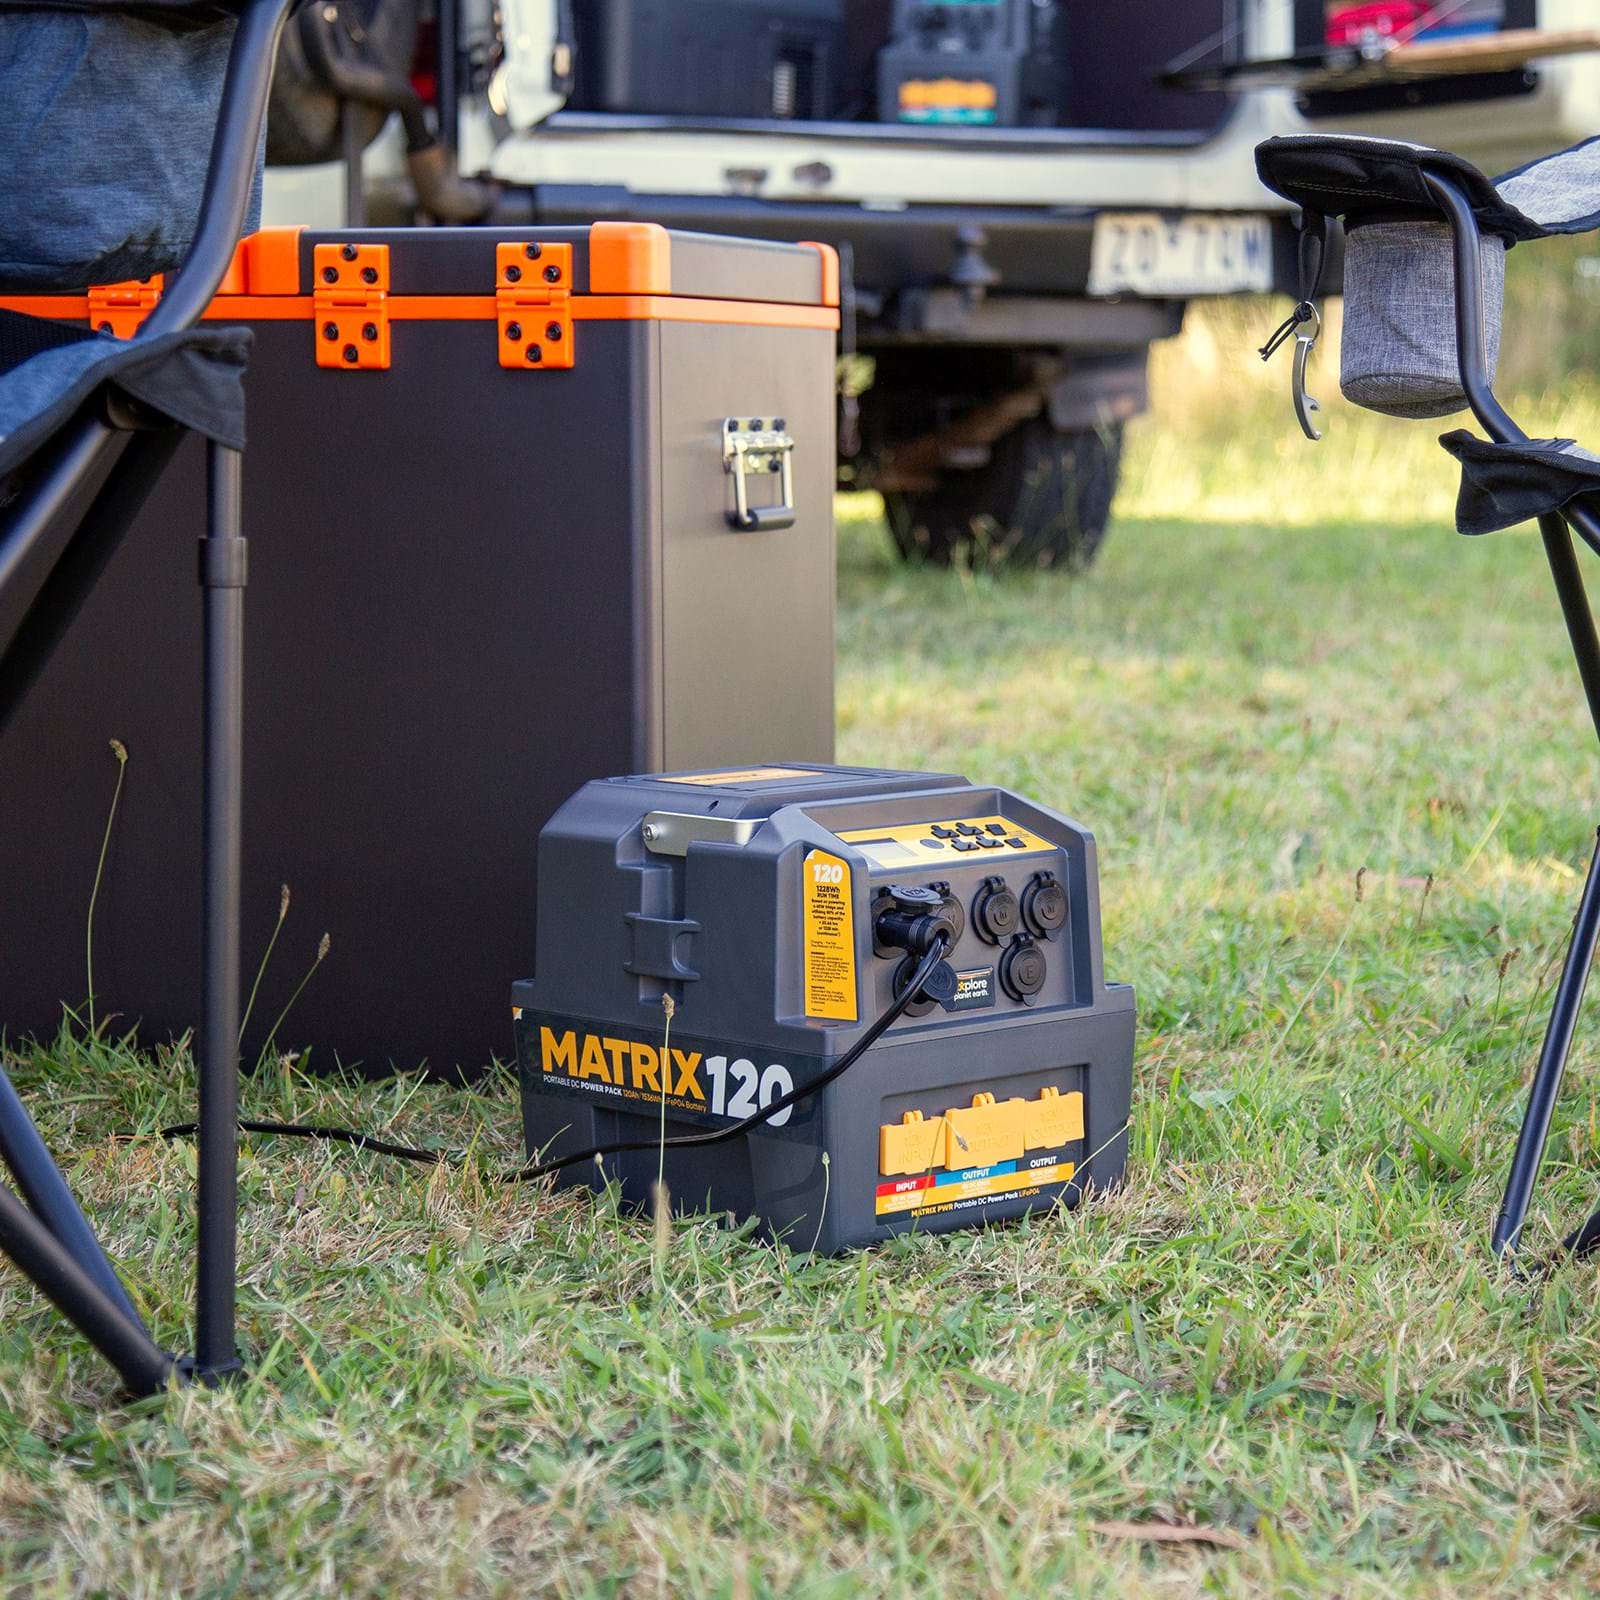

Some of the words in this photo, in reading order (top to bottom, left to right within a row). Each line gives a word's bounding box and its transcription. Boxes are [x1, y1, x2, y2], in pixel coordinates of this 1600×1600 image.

[814, 864, 843, 883] 120
[816, 885, 840, 893] 1228Wh
[958, 979, 987, 993] xplore
[540, 1026, 706, 1101] MATRIX
[705, 1056, 794, 1127] 120
[543, 1074, 570, 1087] PORTABLE
[571, 1079, 580, 1088] DC
[580, 1081, 604, 1093] POWER
[604, 1086, 622, 1096] PACK
[685, 1100, 707, 1113] Battery
[1030, 1155, 1057, 1168] OUTPUT
[962, 1167, 990, 1180] OUTPUT
[895, 1181, 917, 1193] INPUT
[911, 1206, 937, 1217] MATRIX
[937, 1203, 954, 1214] PWR
[953, 1199, 977, 1209] Portable
[977, 1197, 987, 1205] DC
[987, 1194, 1005, 1204] Power
[1004, 1191, 1018, 1201] Pack
